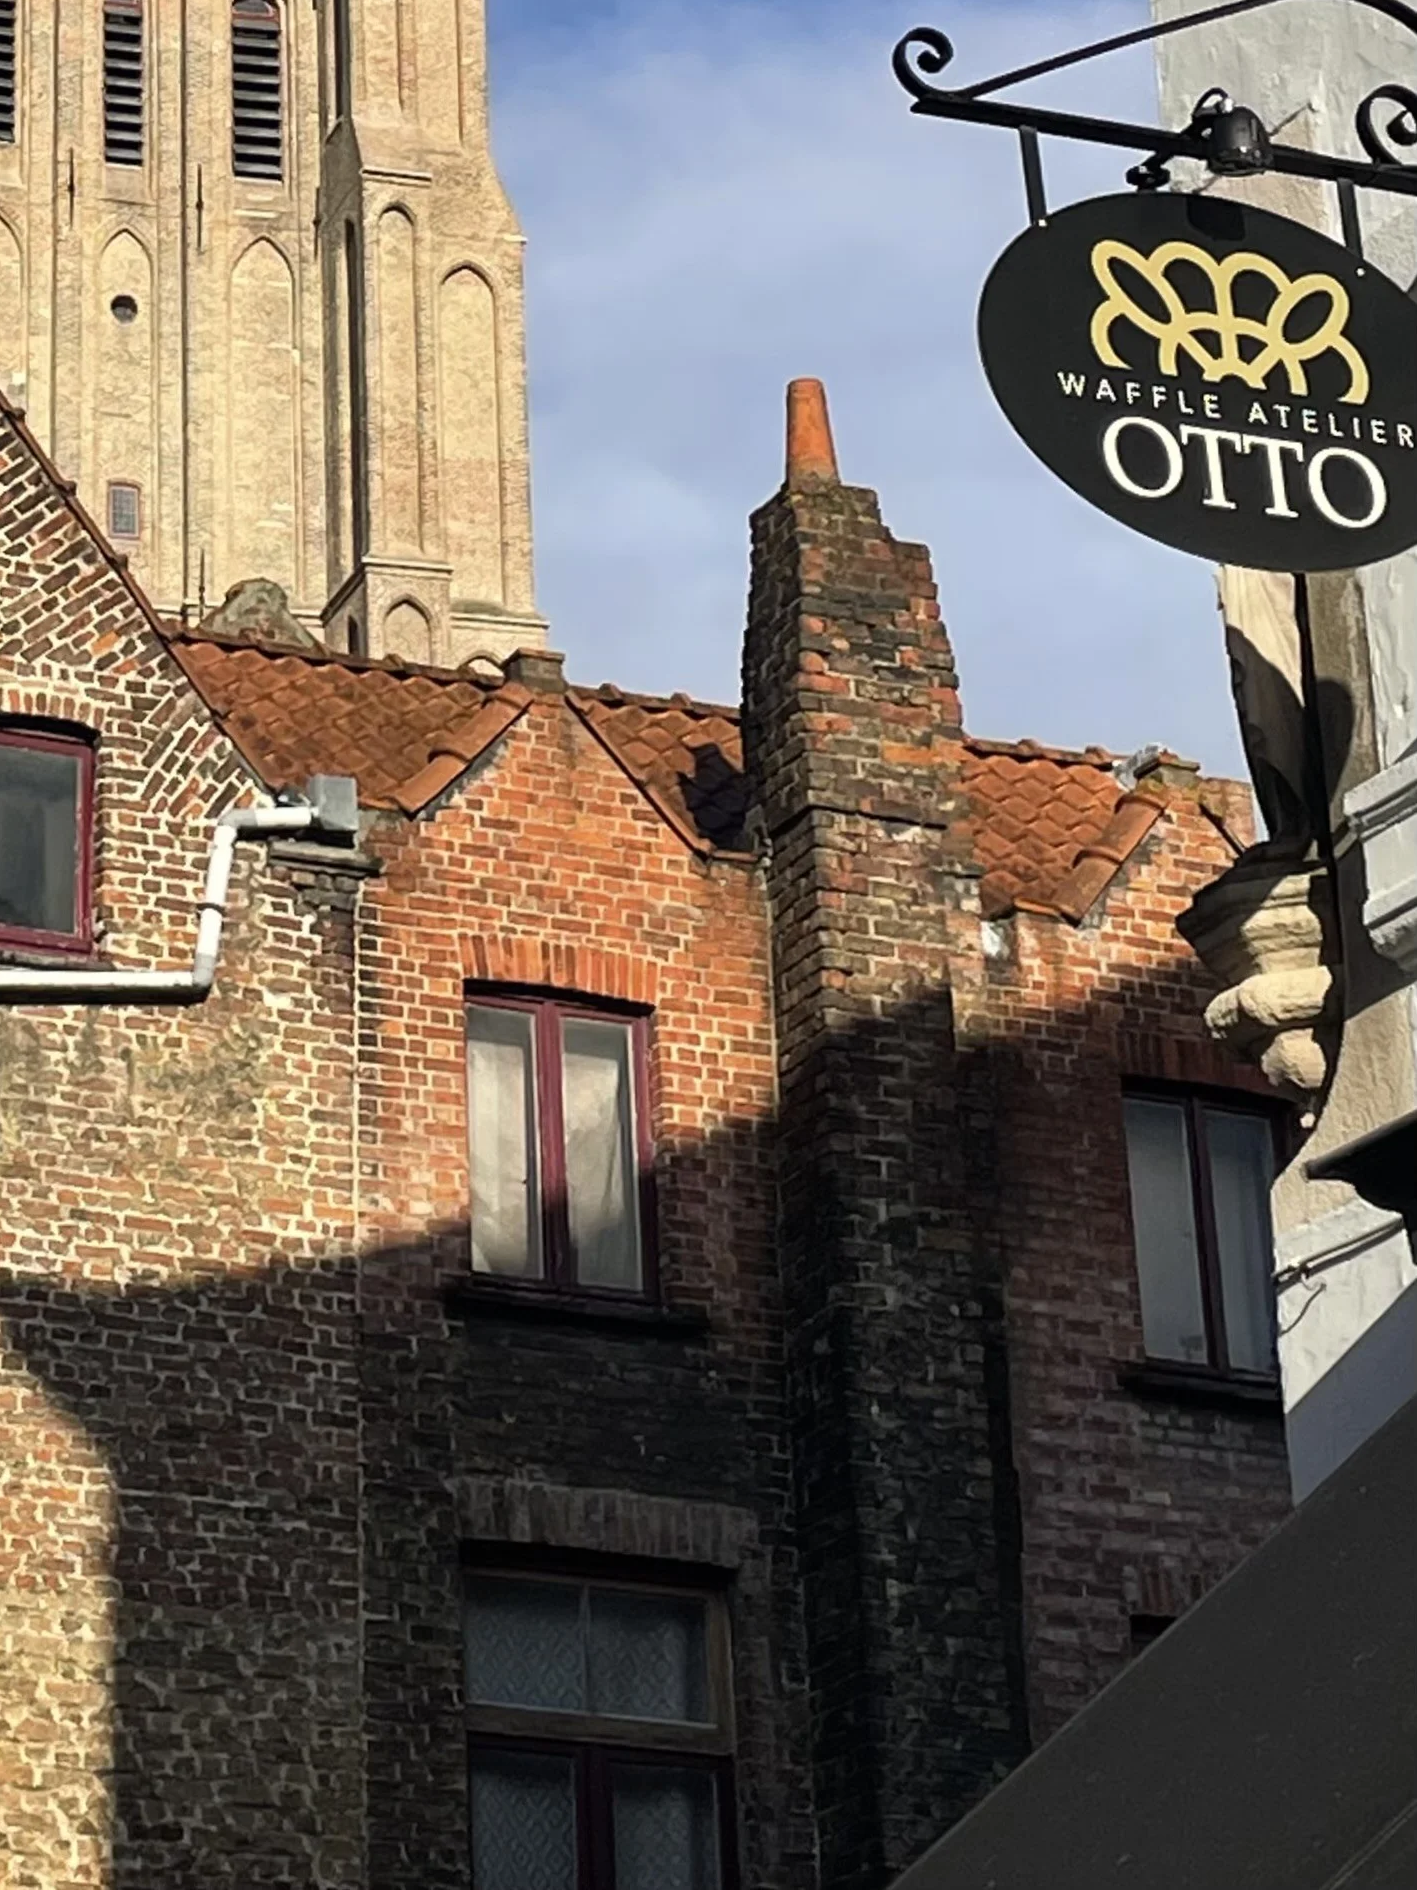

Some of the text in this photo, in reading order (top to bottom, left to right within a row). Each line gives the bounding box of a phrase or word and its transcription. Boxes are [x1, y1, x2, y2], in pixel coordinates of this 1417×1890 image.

[1057, 371, 1415, 448] WAFFLE ATELIER
[1102, 416, 1387, 528] OTTO
